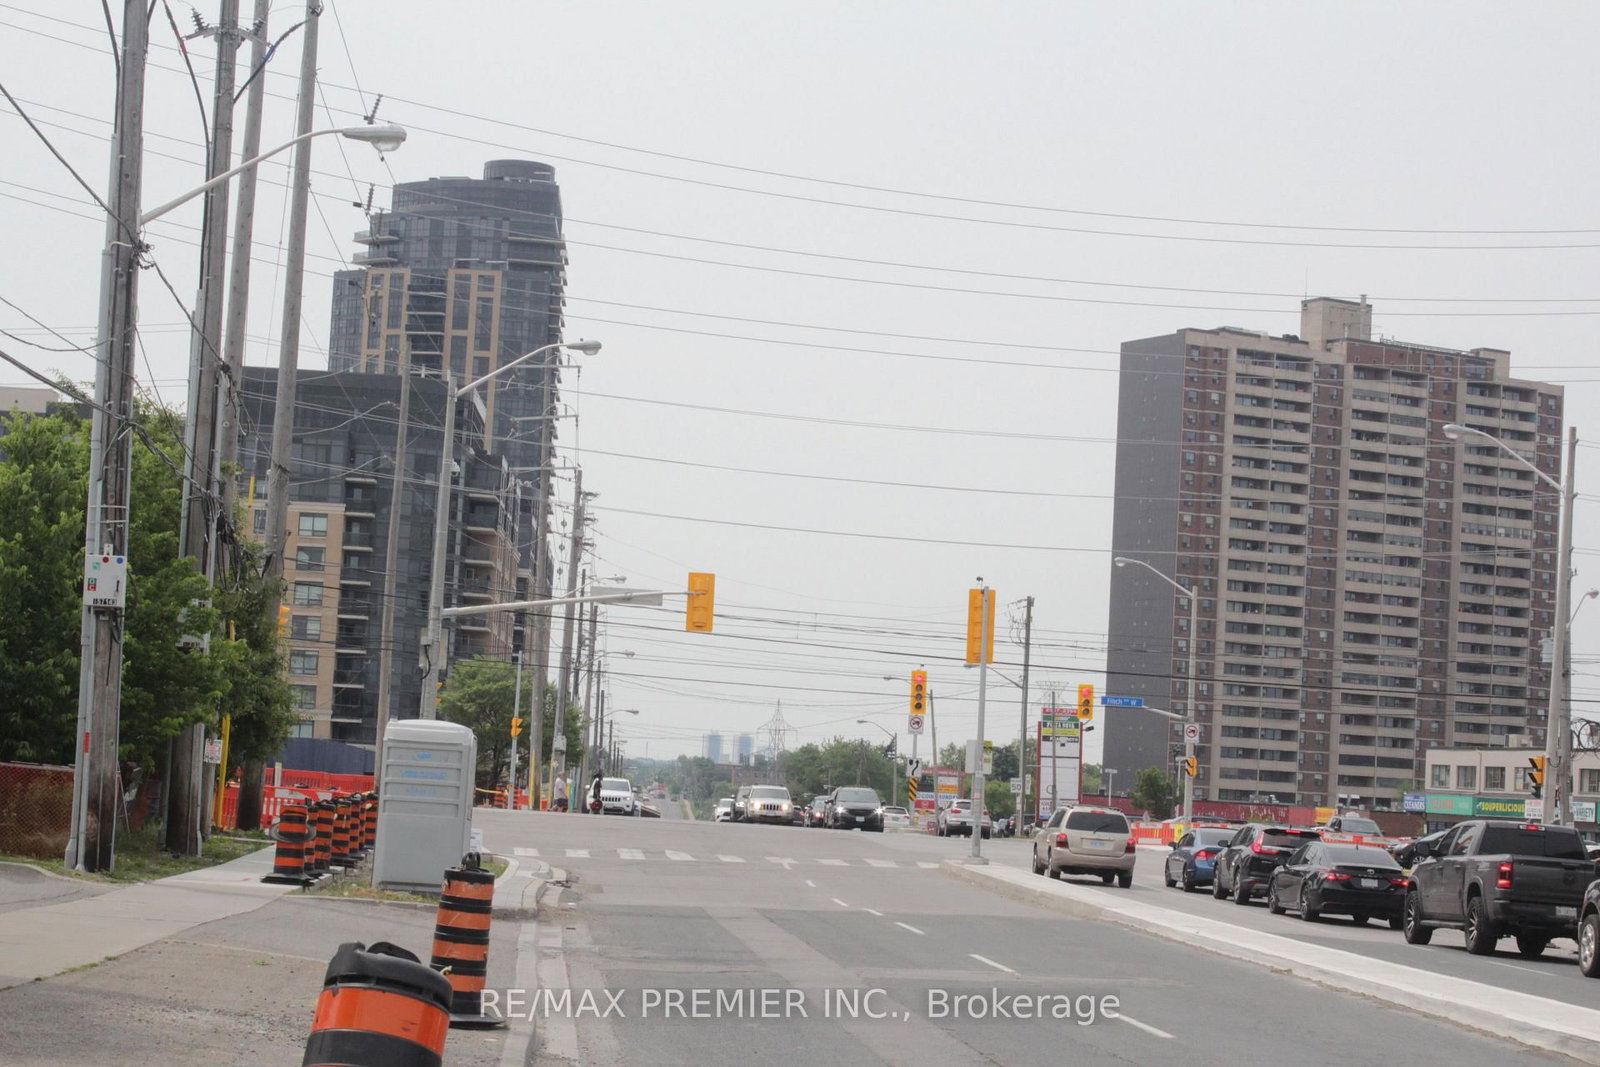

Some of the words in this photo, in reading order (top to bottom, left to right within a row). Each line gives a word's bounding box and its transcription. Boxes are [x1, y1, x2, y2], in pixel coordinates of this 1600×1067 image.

[1011, 783, 1022, 791] 50
[1404, 800, 1425, 810] CLEANERS
[1481, 801, 1525, 812] SOUPERLICIOUS
